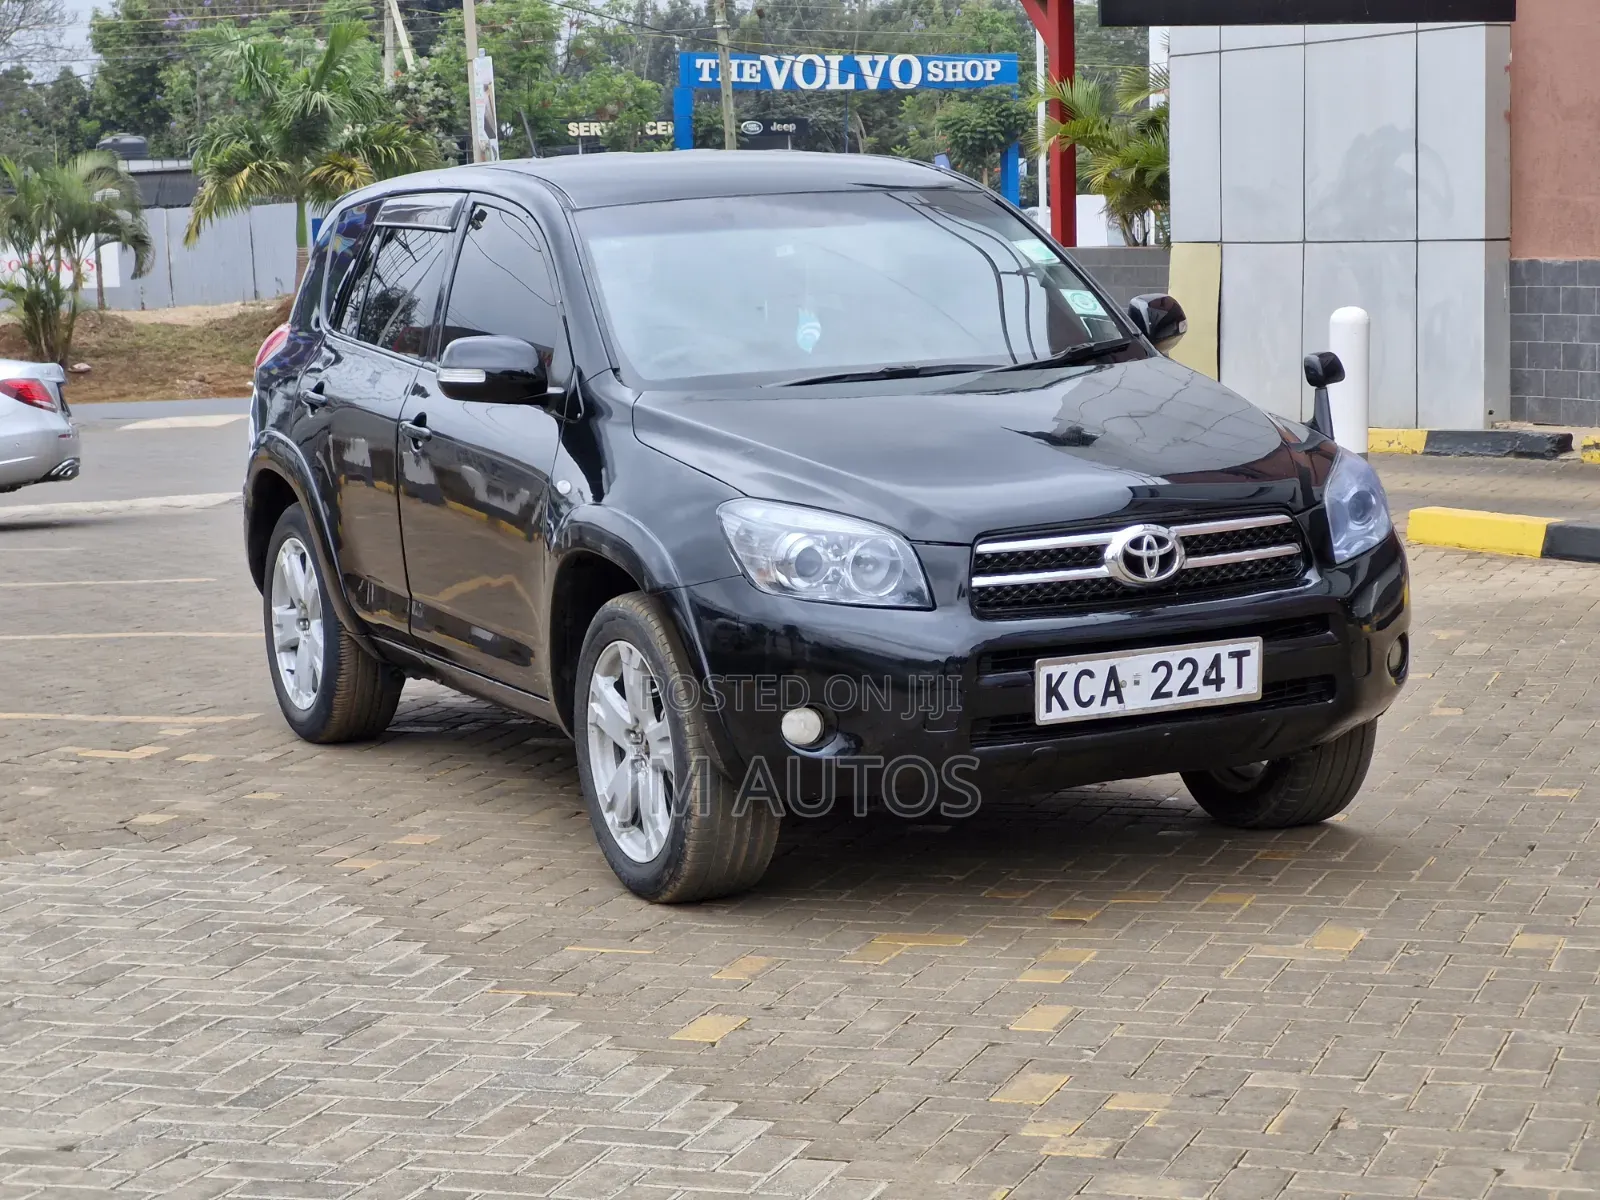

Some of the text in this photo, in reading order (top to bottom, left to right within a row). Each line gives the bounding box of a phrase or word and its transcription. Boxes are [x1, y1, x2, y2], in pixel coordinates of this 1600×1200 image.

[760, 54, 923, 90] VOLVO
[927, 59, 1002, 83] SHOP
[770, 121, 797, 133] Jeep
[1045, 649, 1252, 714] KCA 224T
